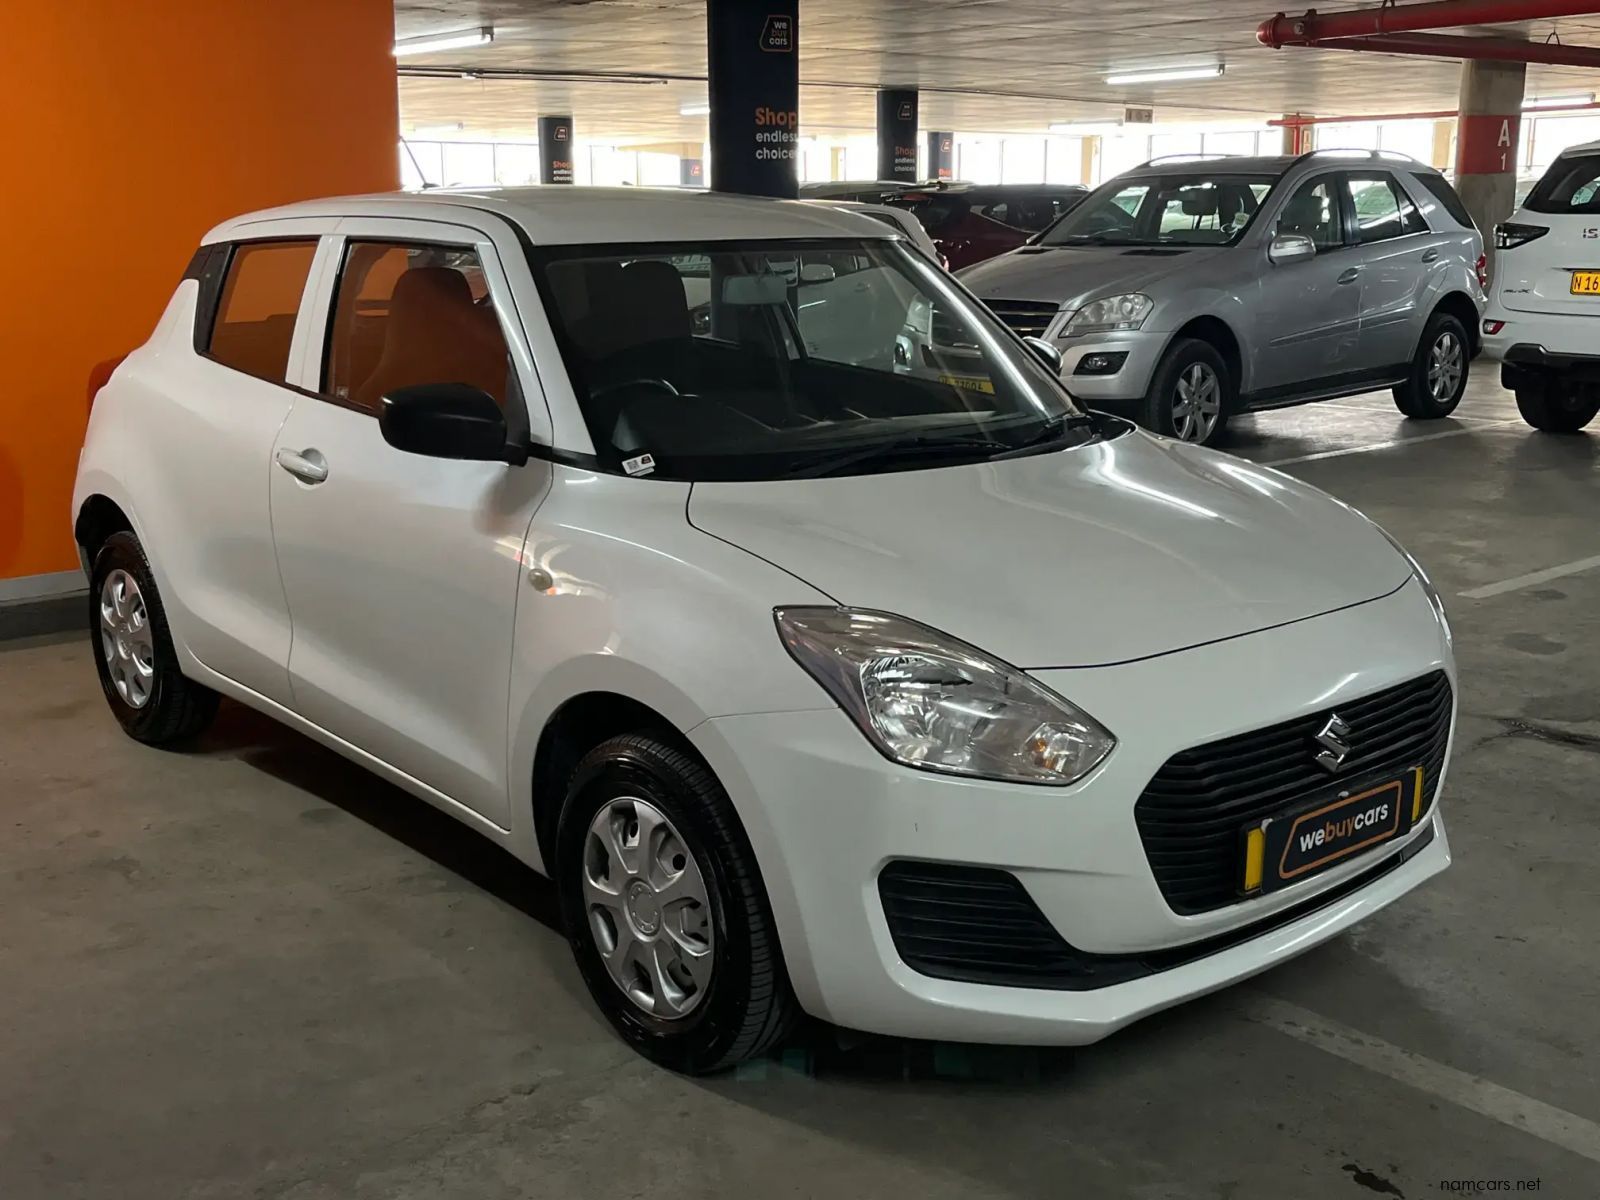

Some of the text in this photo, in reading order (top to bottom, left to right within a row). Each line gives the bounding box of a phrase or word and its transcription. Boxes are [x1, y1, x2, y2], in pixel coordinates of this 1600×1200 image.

[773, 21, 787, 29] we
[769, 37, 788, 46] cars
[755, 107, 797, 129] Shop
[1497, 119, 1511, 147] A
[1500, 153, 1506, 171] 1
[1573, 276, 1600, 291] N 16
[1300, 803, 1389, 852] webuycars
